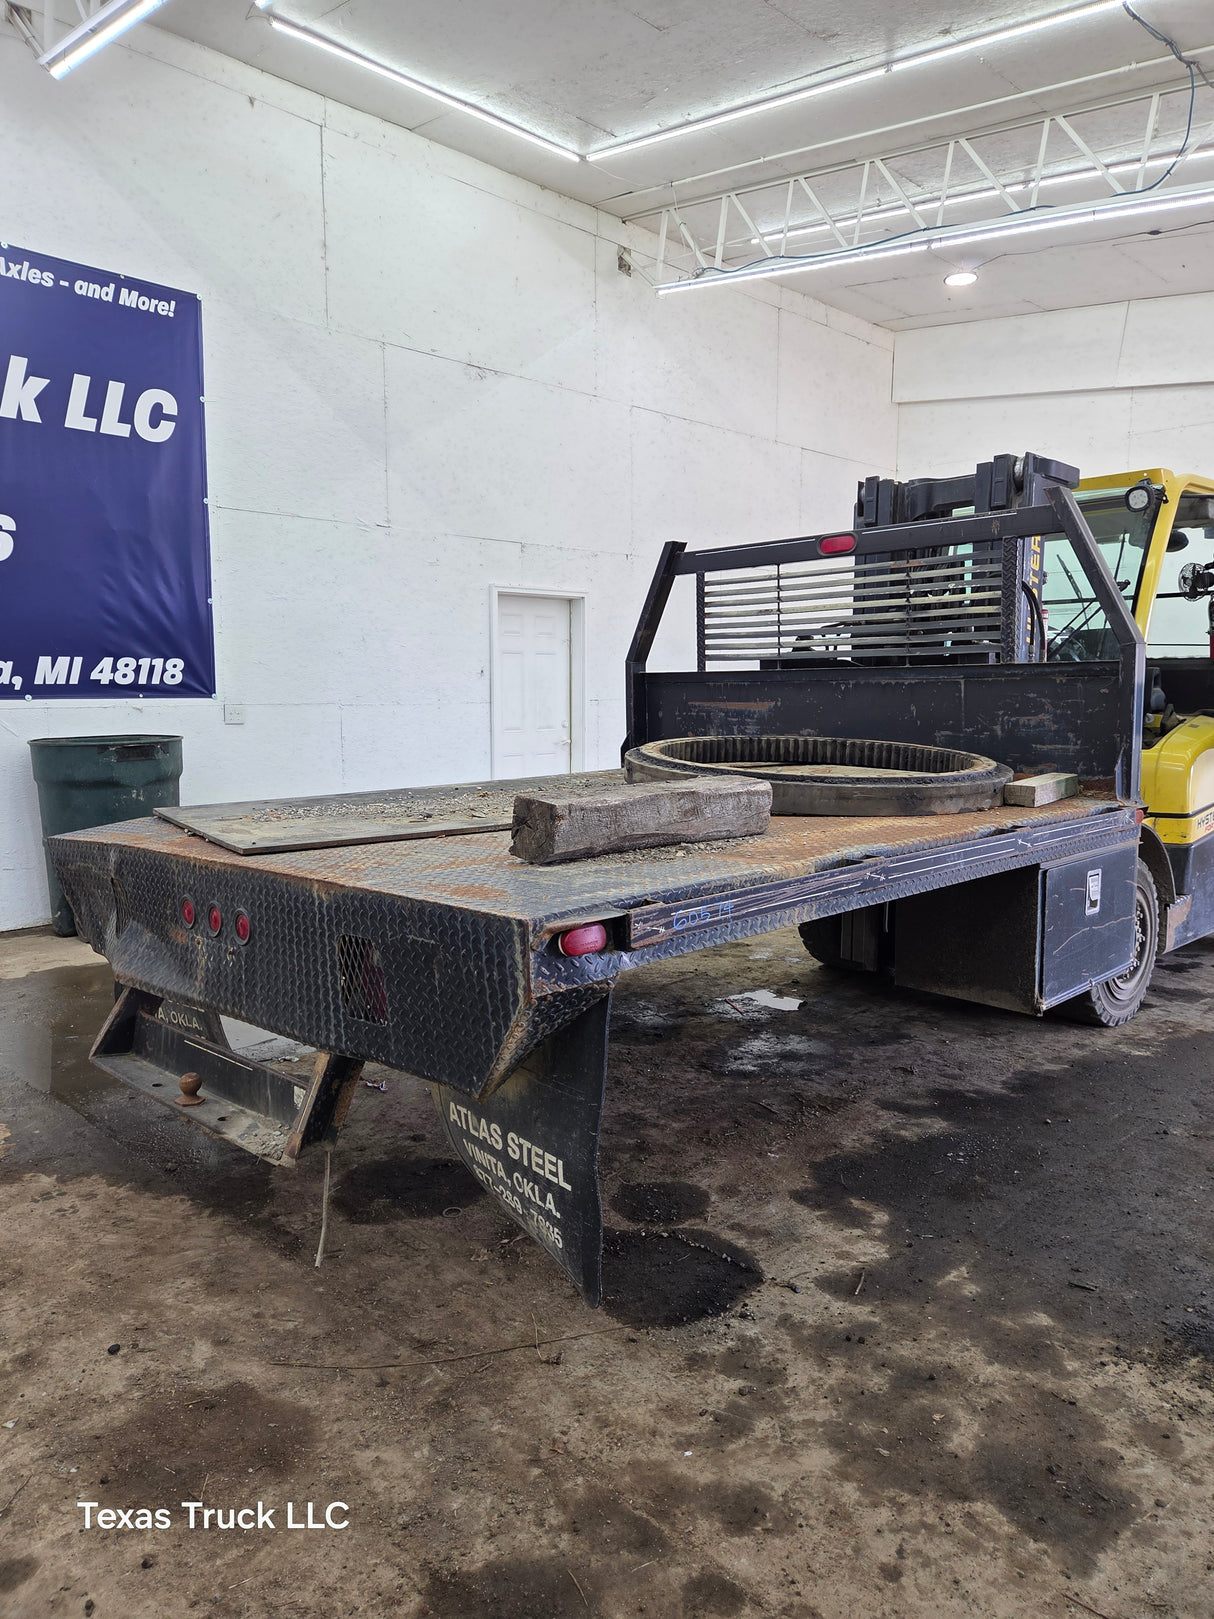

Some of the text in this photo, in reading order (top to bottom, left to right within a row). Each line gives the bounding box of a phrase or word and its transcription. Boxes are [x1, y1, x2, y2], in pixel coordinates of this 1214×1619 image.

[74, 279, 115, 302] and
[118, 288, 176, 318] More!
[64, 373, 178, 443] LLC
[34, 655, 83, 685] MI
[90, 656, 185, 685] 48118
[170, 1010, 203, 1031] OKLA.
[450, 1101, 572, 1192] ATLAS STEEL
[462, 1138, 561, 1219] VINITA, OKLA.
